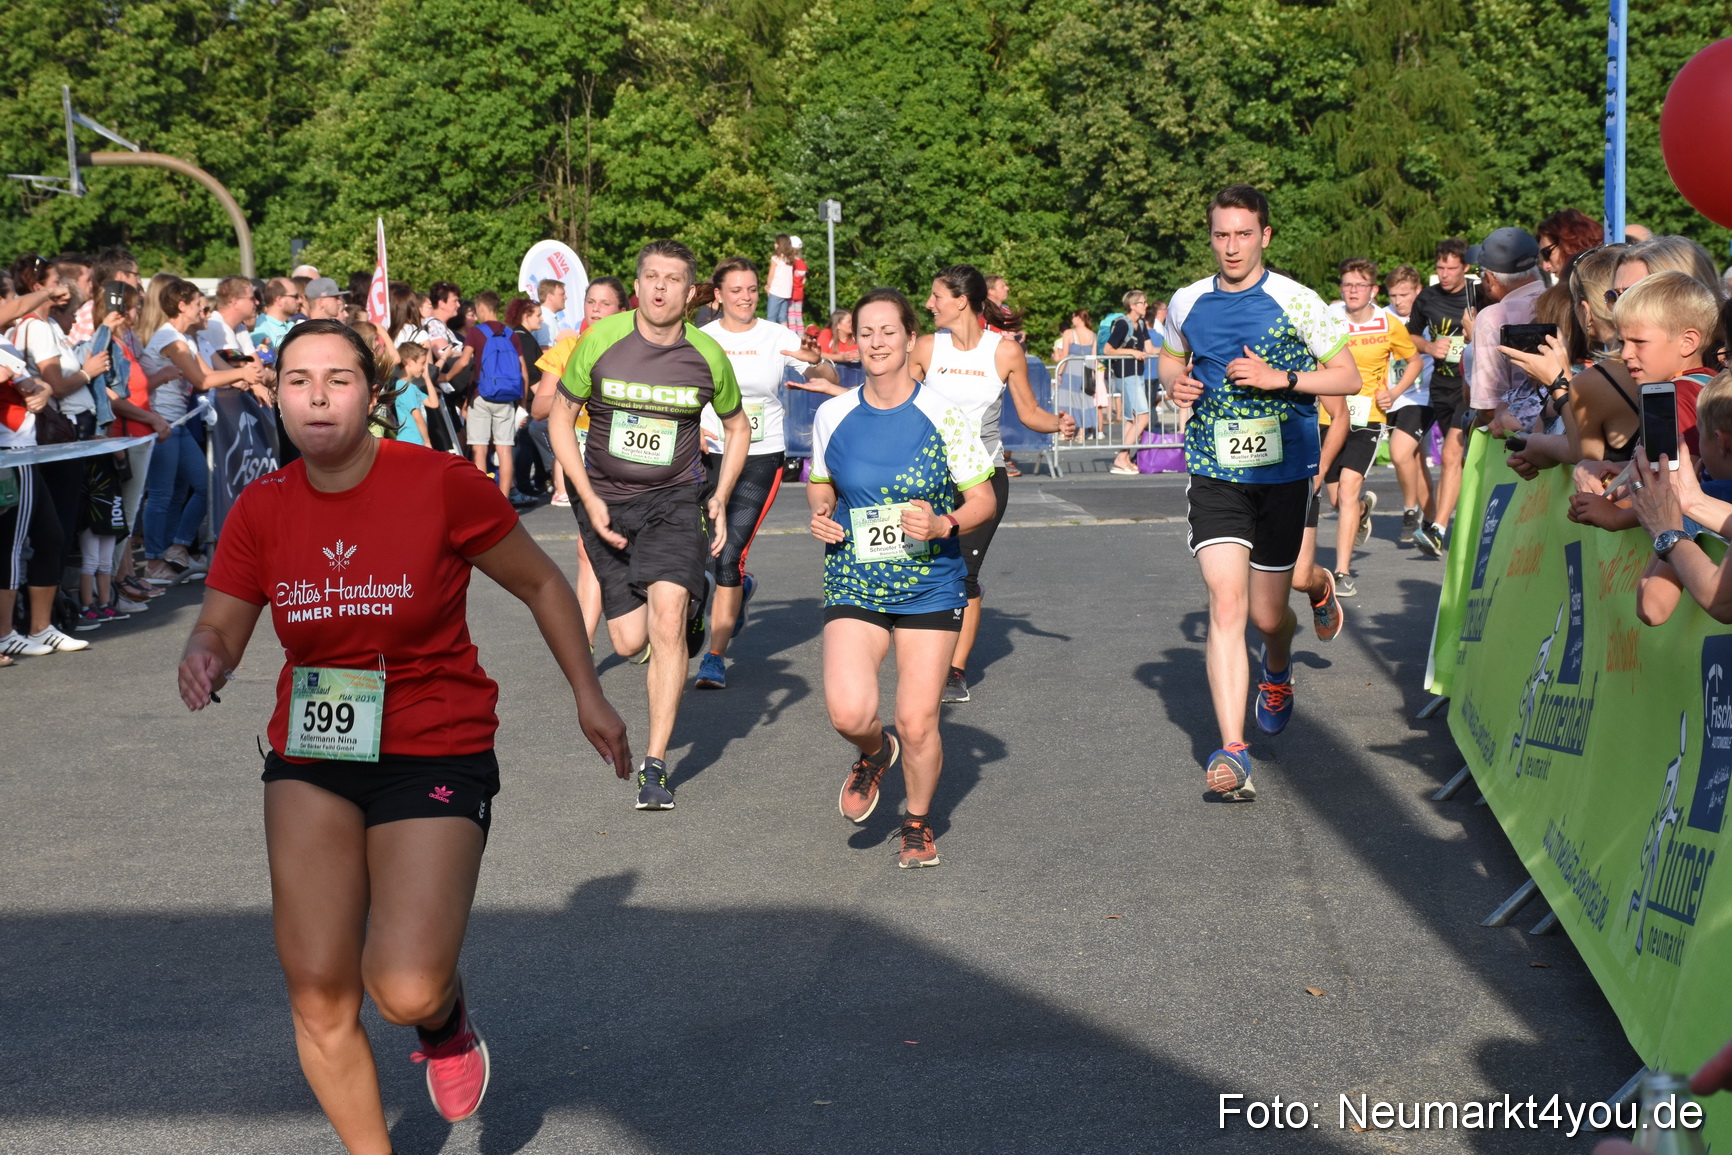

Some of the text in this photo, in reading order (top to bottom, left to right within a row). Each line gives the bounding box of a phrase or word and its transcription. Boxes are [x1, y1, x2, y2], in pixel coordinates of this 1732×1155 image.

[1361, 335, 1389, 346] BÖGL
[949, 368, 985, 377] KLEBL
[602, 379, 699, 406] BOCK
[633, 402, 643, 410] by
[645, 405, 668, 413] smart
[623, 430, 661, 451] 306
[1229, 435, 1267, 455] 242
[276, 573, 414, 607] Echtes Handwerk
[287, 603, 393, 623] IMMER FRISCH
[303, 701, 355, 734] 599
[300, 733, 358, 744] Kellermann Nina
[428, 792, 450, 804] adidas
[1647, 924, 1686, 967] neumarkt
